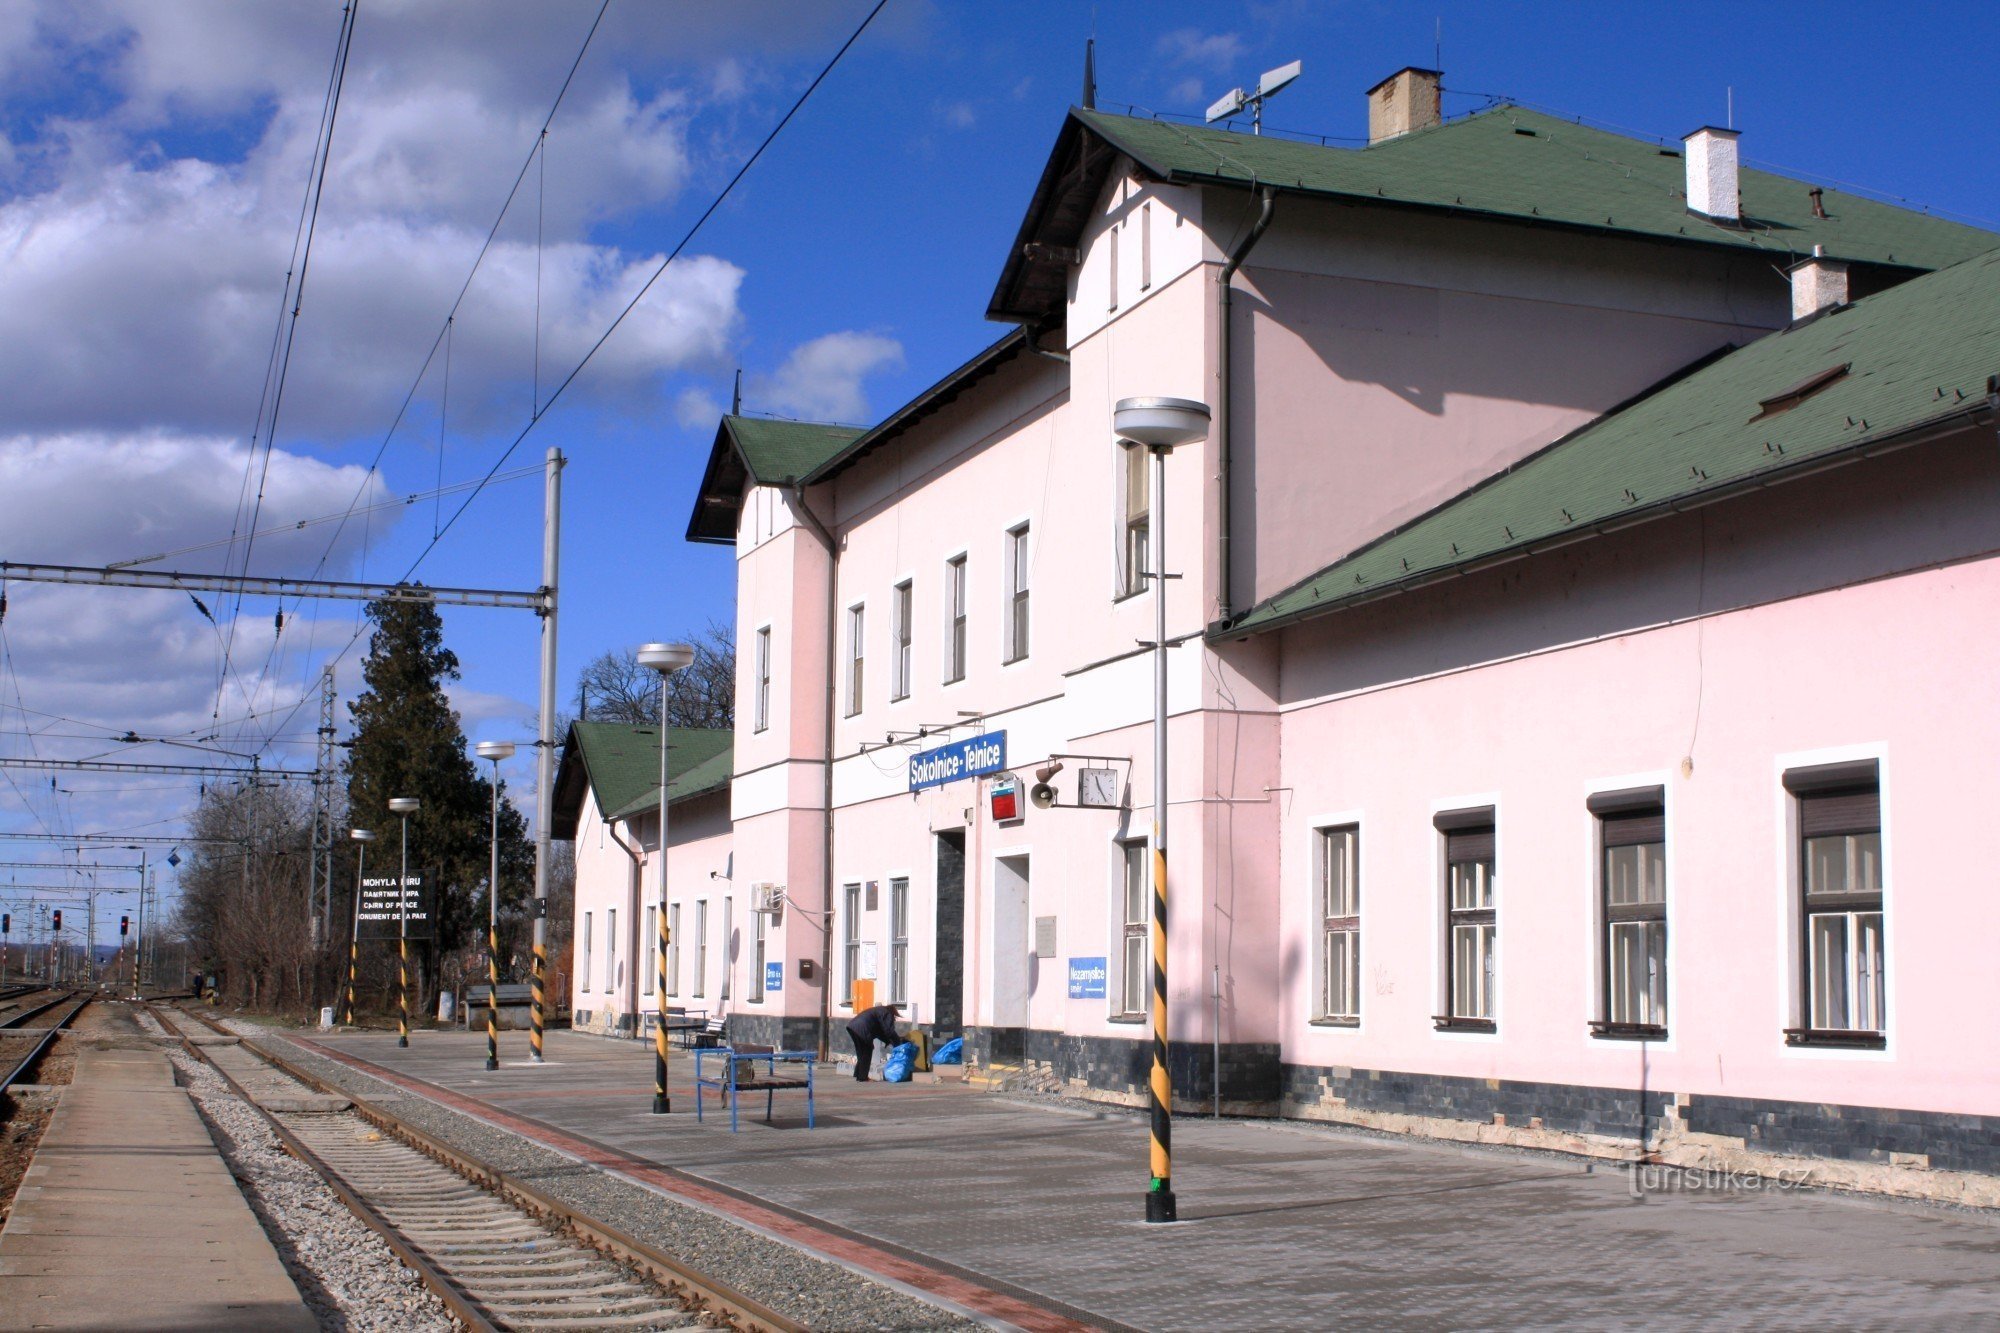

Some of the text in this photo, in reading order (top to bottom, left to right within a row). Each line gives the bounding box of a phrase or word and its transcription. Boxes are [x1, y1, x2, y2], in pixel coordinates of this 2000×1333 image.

[911, 740, 1000, 785] Sokolnice-Telnice
[363, 878, 397, 887] MOHYLA
[363, 890, 400, 898] ПАМЯТНИК
[385, 901, 394, 909] OF
[411, 912, 427, 920] PAIX
